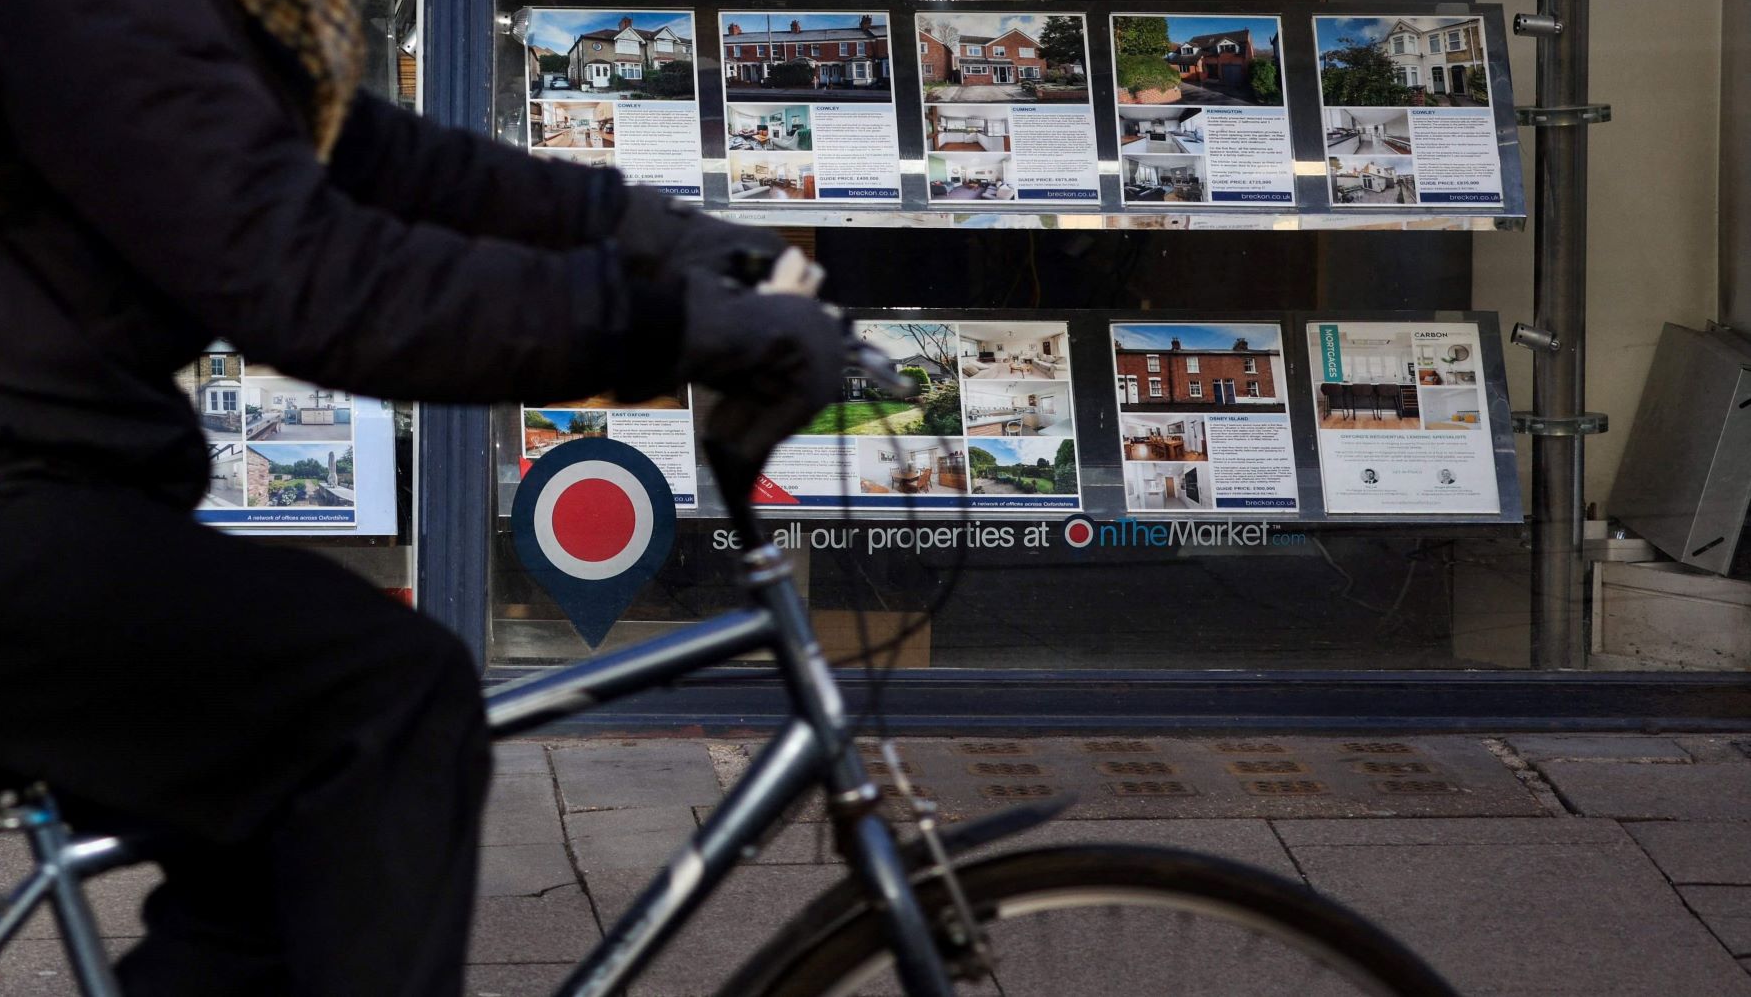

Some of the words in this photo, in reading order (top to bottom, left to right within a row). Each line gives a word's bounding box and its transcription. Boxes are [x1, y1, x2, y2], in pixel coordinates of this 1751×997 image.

[1325, 329, 1337, 378] MORTGAGES
[712, 529, 743, 550] se
[773, 522, 800, 549] all
[811, 528, 860, 549] our
[868, 521, 1015, 555] properties
[1024, 521, 1049, 546] at
